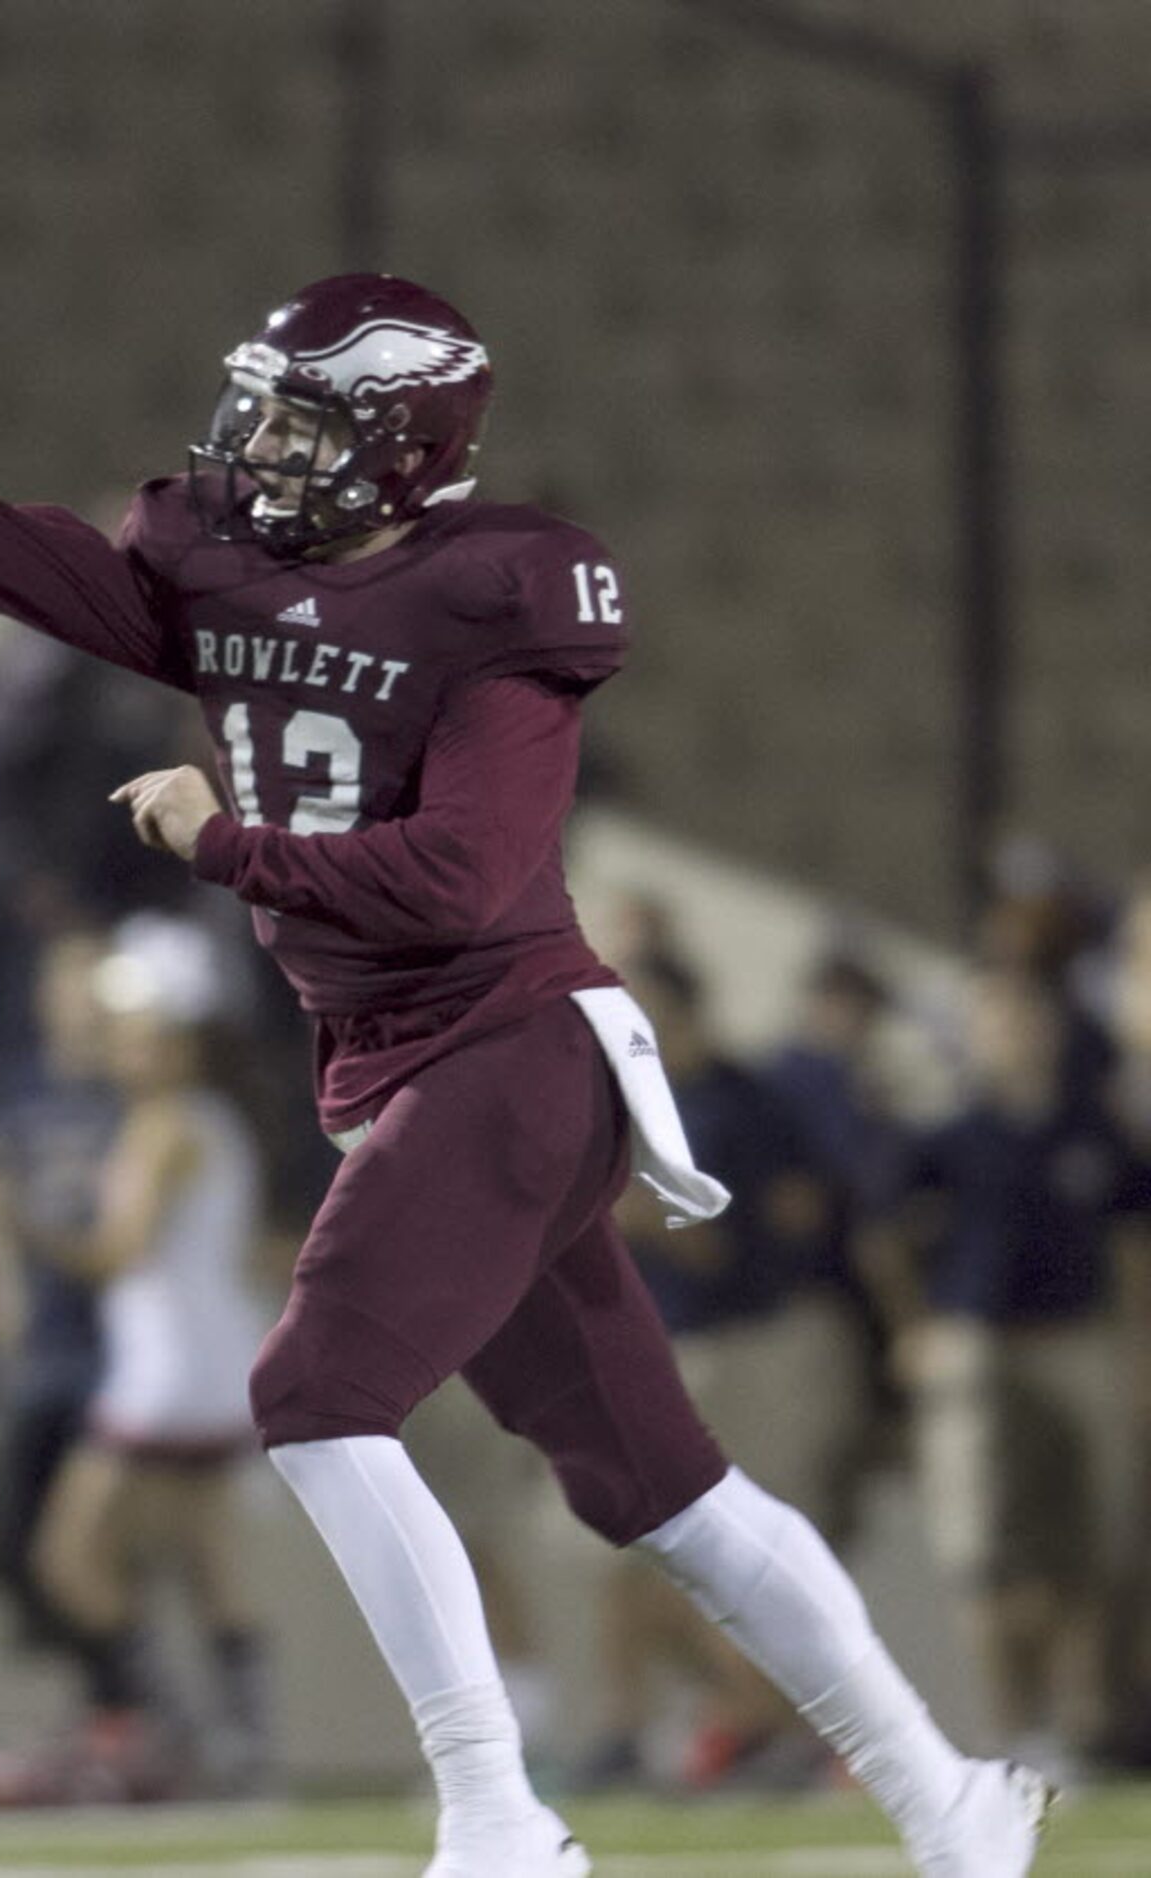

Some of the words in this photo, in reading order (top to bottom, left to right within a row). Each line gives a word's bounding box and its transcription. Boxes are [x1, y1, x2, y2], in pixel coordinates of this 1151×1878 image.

[573, 563, 622, 624] 12
[196, 629, 410, 700] ROWLETT
[222, 703, 362, 837] 12
